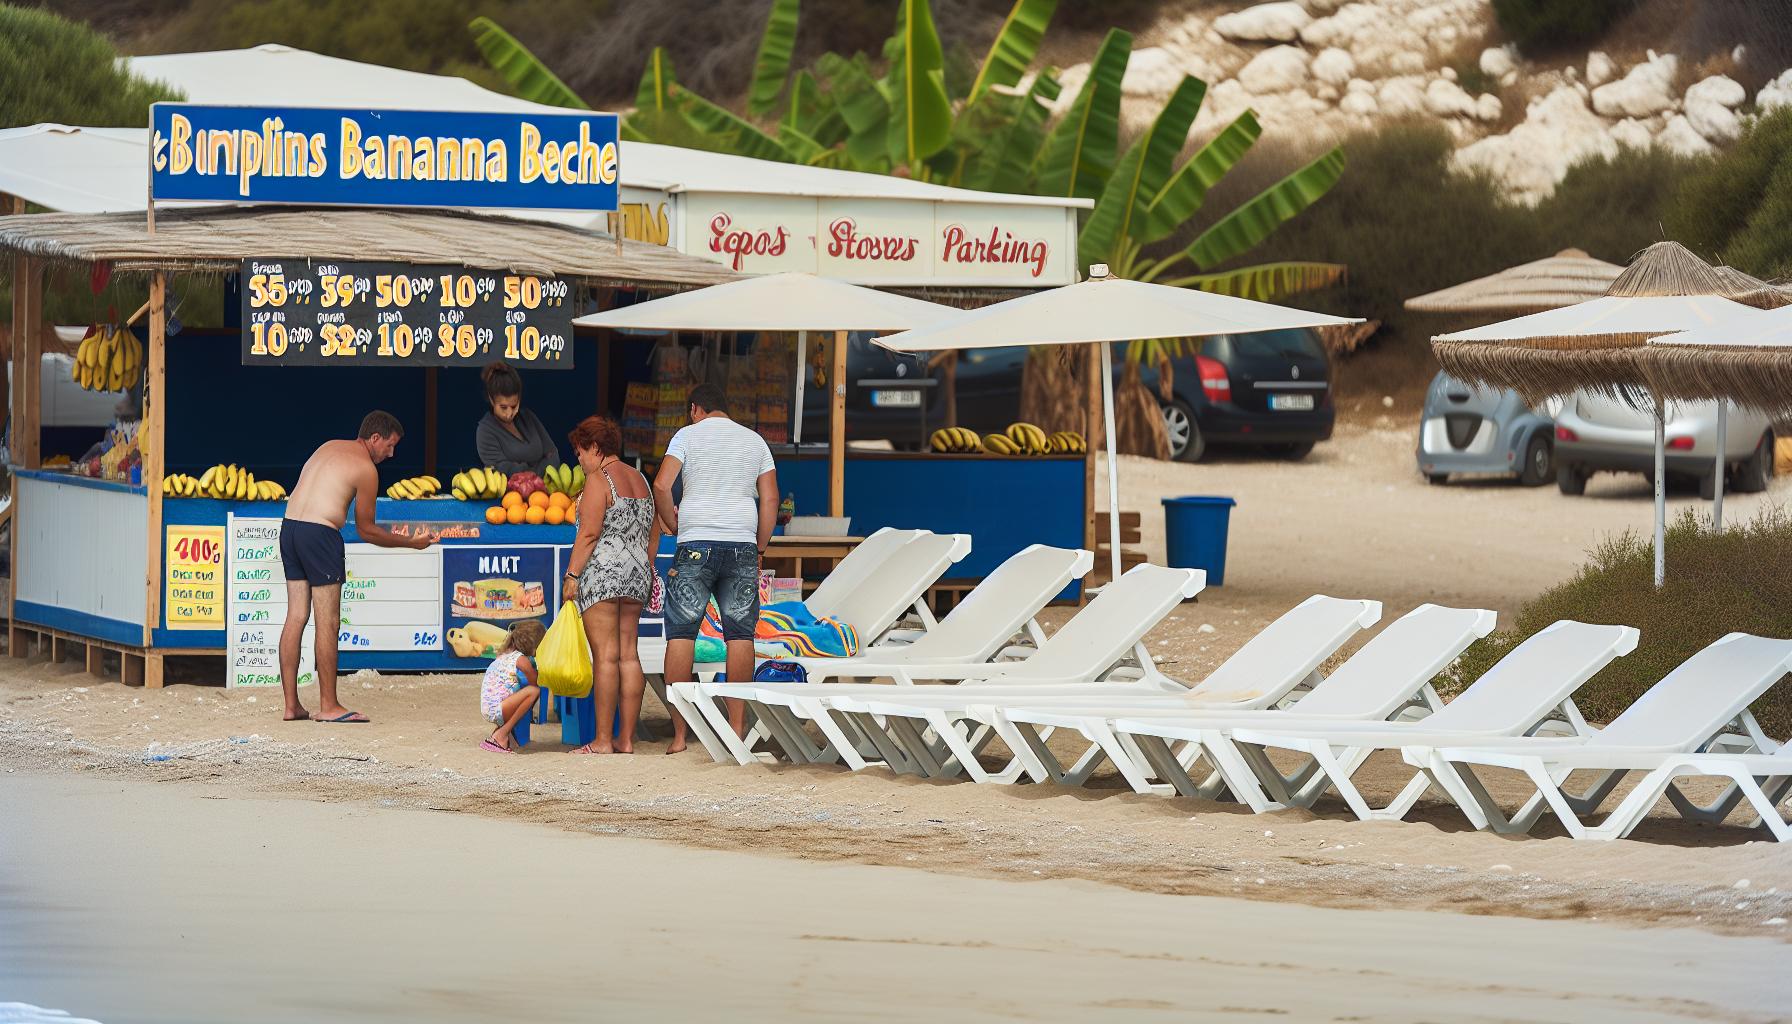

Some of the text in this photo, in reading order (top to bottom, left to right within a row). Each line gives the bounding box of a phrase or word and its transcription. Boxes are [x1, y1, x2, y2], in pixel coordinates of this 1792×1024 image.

[340, 117, 507, 183] Bananna
[519, 121, 617, 185] Beche
[943, 226, 1047, 277] Parking
[375, 275, 412, 307] 50
[440, 275, 476, 307] 10
[503, 276, 541, 309] 50
[250, 323, 288, 356] 10
[377, 323, 414, 357] 10
[504, 325, 540, 360] 10
